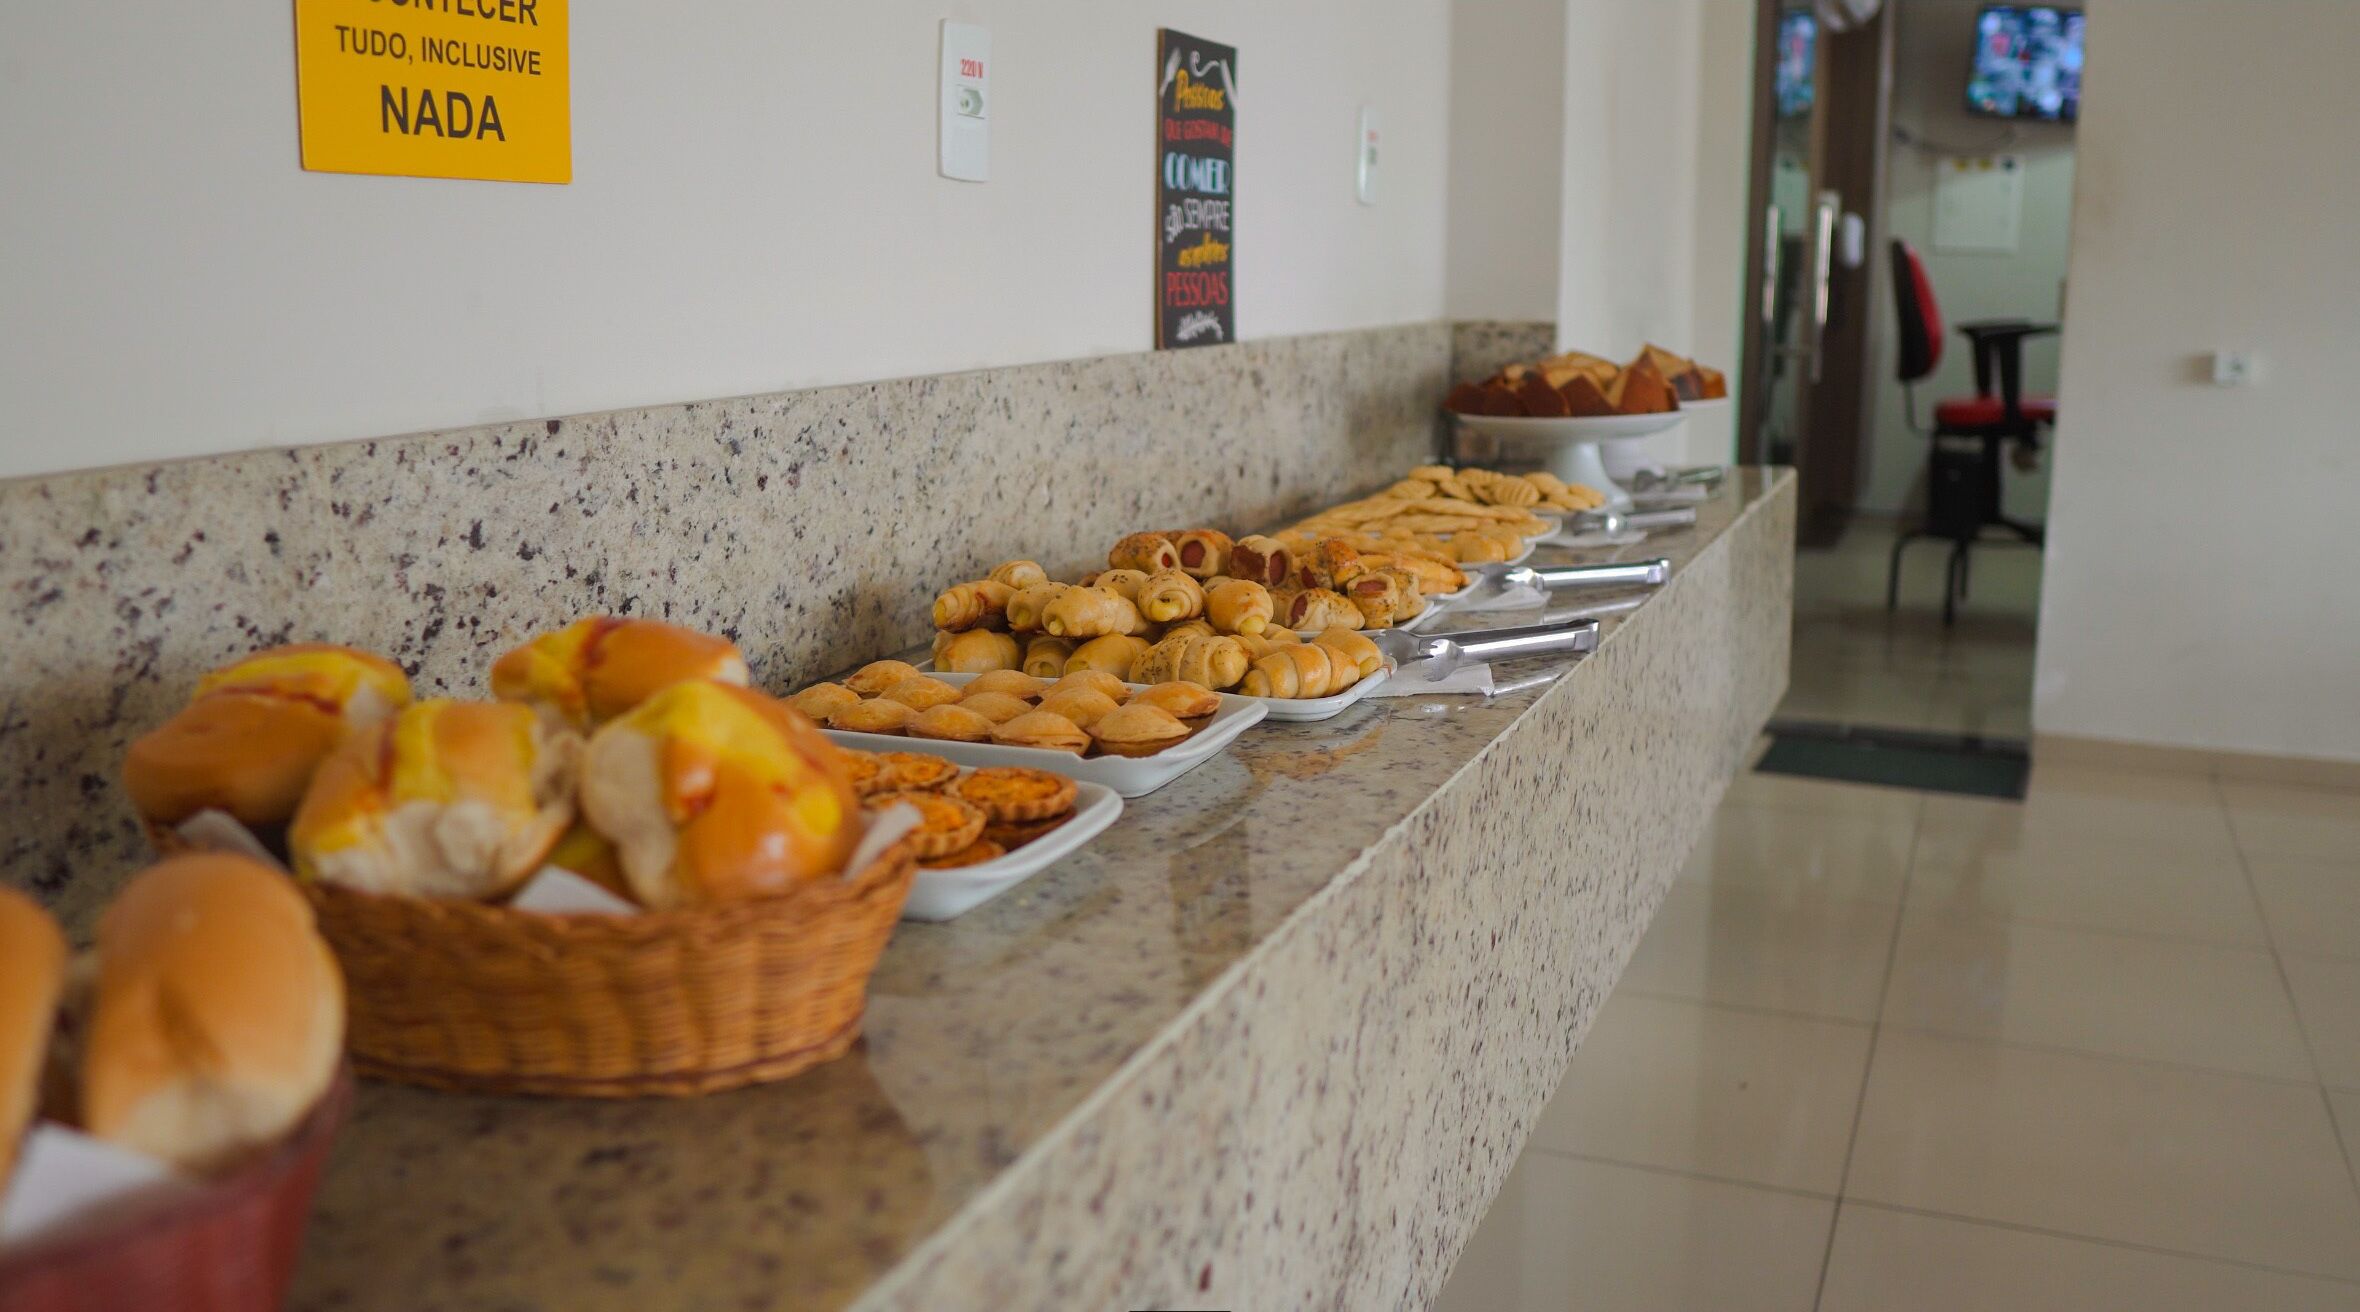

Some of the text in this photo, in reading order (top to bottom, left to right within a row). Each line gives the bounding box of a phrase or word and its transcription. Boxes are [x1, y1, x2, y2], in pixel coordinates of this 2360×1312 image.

[335, 25, 541, 75] TUDO, INCLUSIVE
[960, 59, 976, 77] 220
[381, 85, 506, 142] NADA
[1165, 152, 1230, 194] COMER
[1183, 198, 1230, 231] SEMPRE
[1166, 272, 1229, 306] PESSOAS
